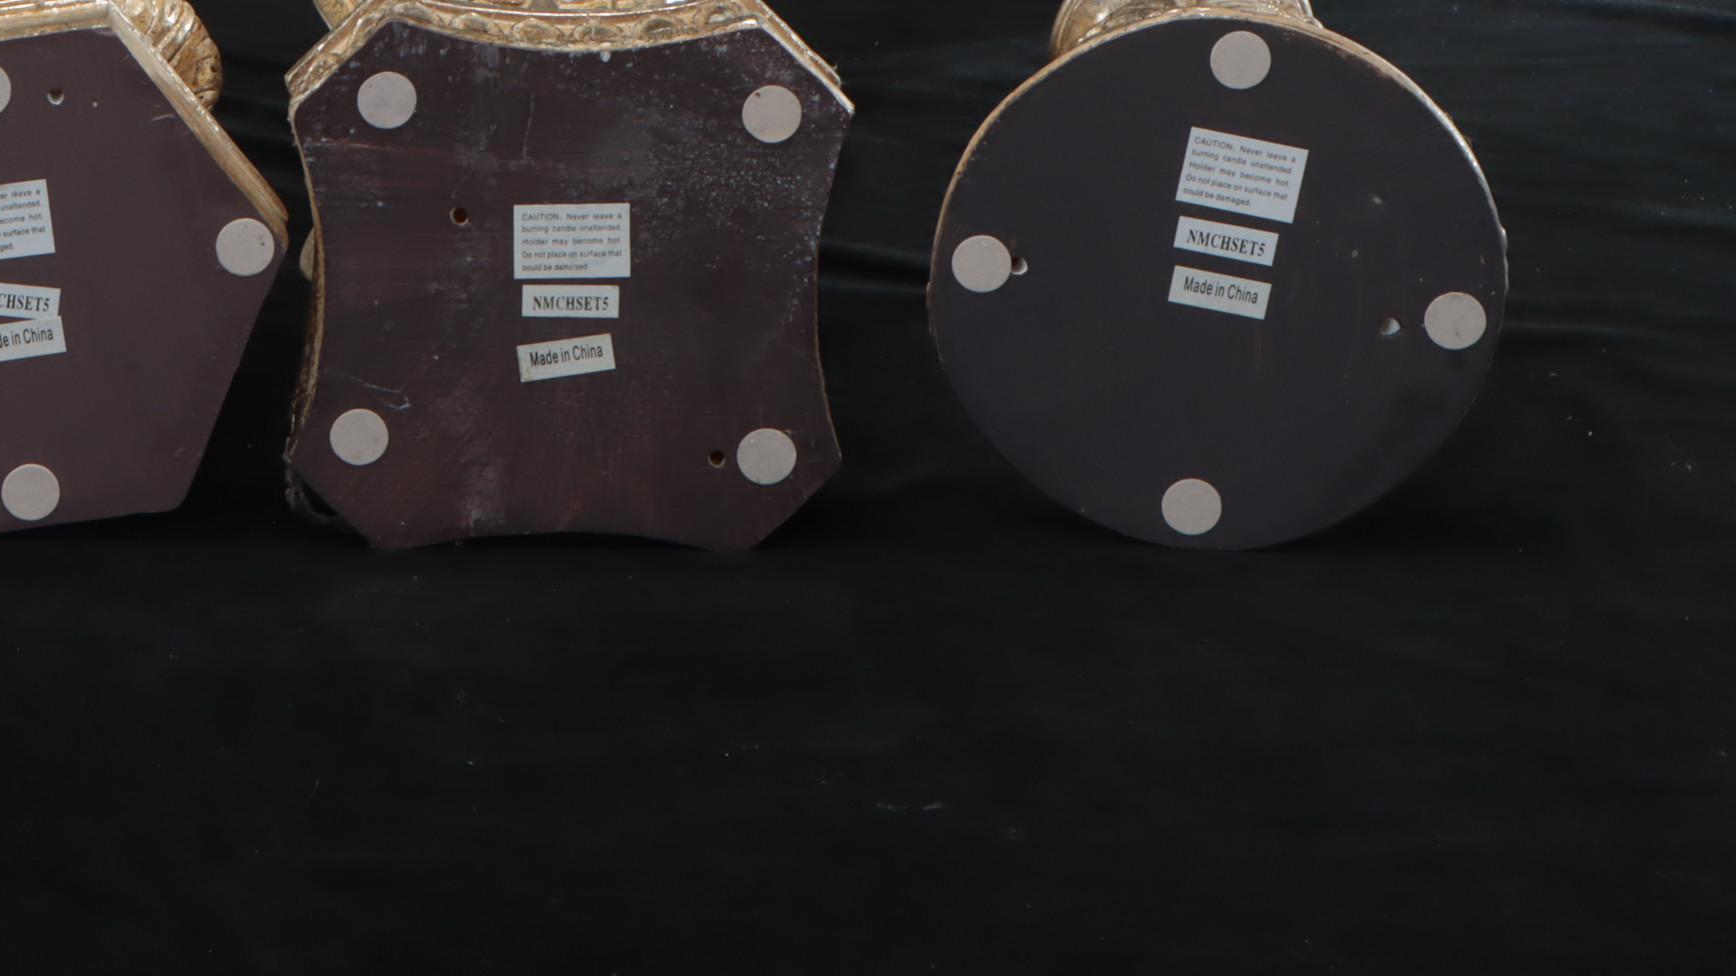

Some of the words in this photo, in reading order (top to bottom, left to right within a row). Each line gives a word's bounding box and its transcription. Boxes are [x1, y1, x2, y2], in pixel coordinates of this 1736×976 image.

[1187, 229, 1266, 257] NMCHSET5
[1184, 276, 1213, 295] Made
[1215, 282, 1224, 295] in
[1227, 284, 1258, 304] China
[533, 296, 609, 311] NMCHSET5
[12, 332, 21, 346] in
[23, 327, 53, 344] China
[530, 352, 558, 367] Made
[561, 348, 570, 362] in
[573, 344, 603, 361] China
